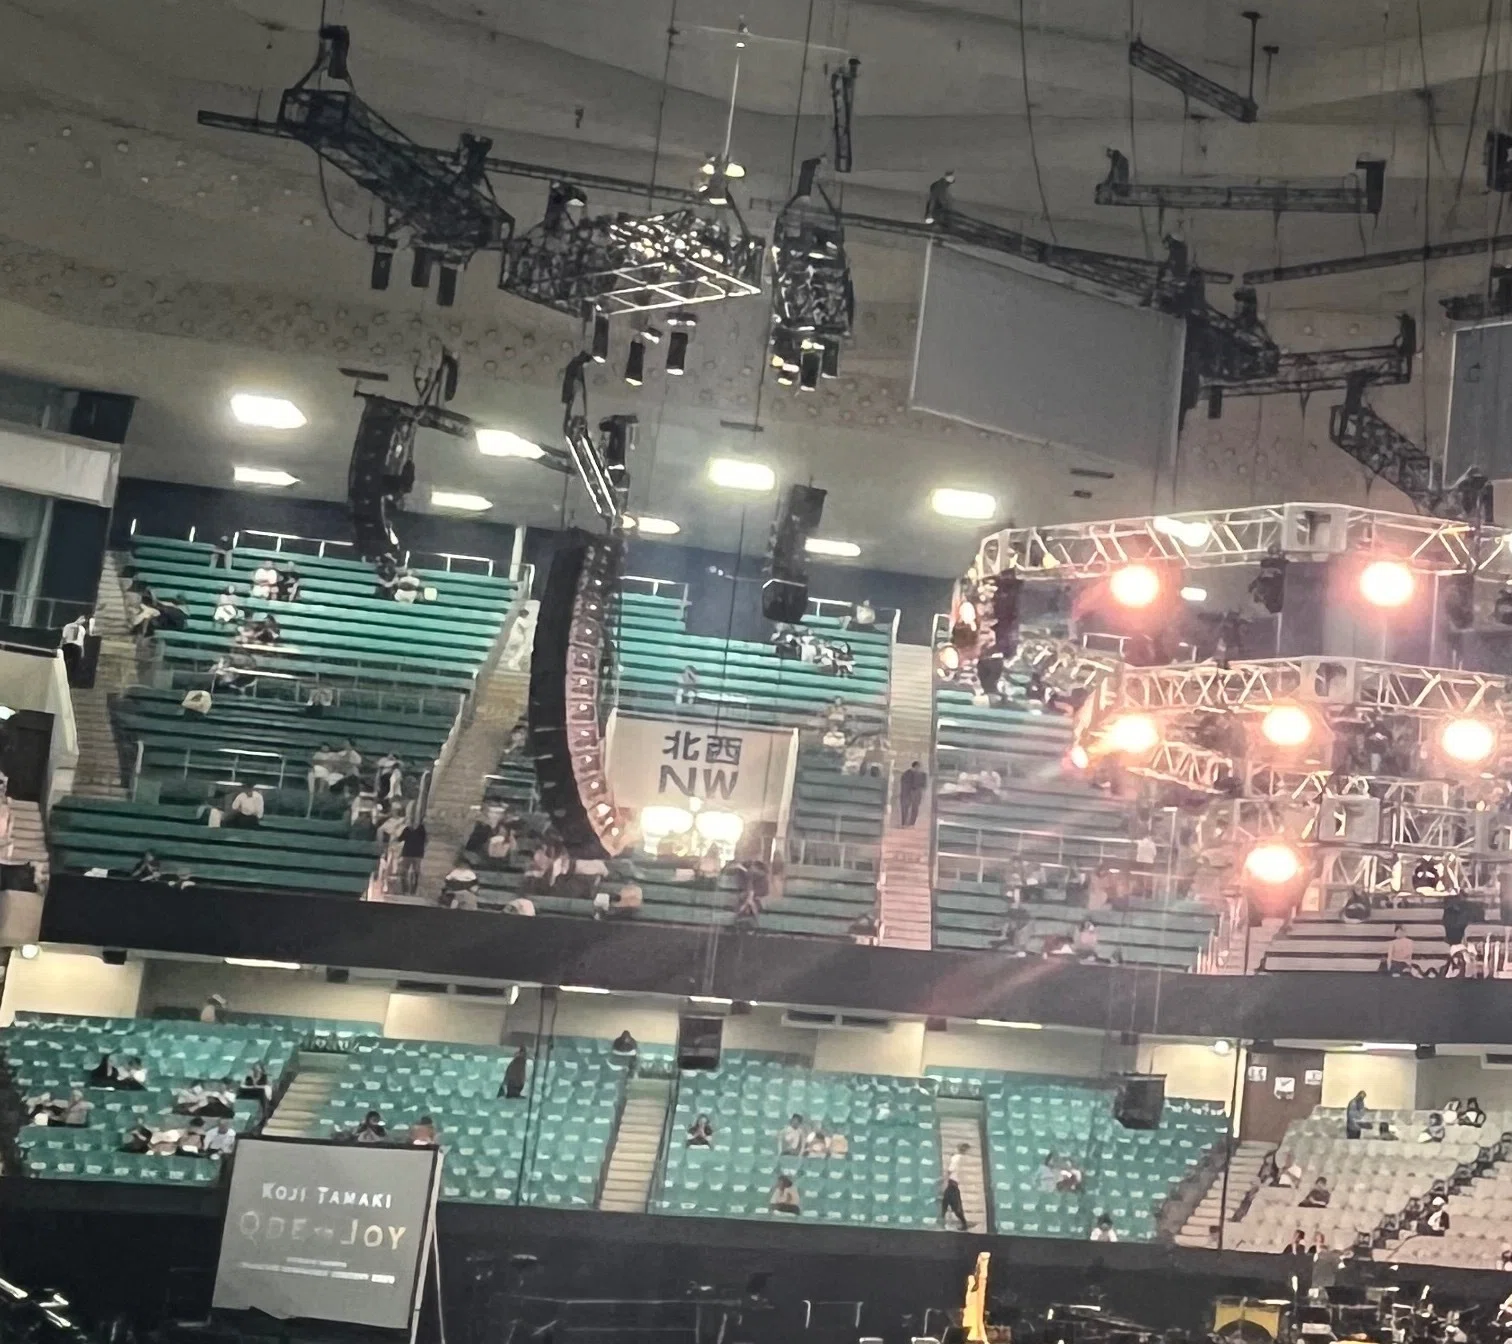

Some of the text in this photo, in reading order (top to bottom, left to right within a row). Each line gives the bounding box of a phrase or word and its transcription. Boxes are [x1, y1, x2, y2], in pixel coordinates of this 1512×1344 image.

[661, 730, 743, 766] 北西
[658, 764, 739, 800] NW
[262, 1182, 306, 1203] KOJI
[340, 1218, 407, 1250] JOY
